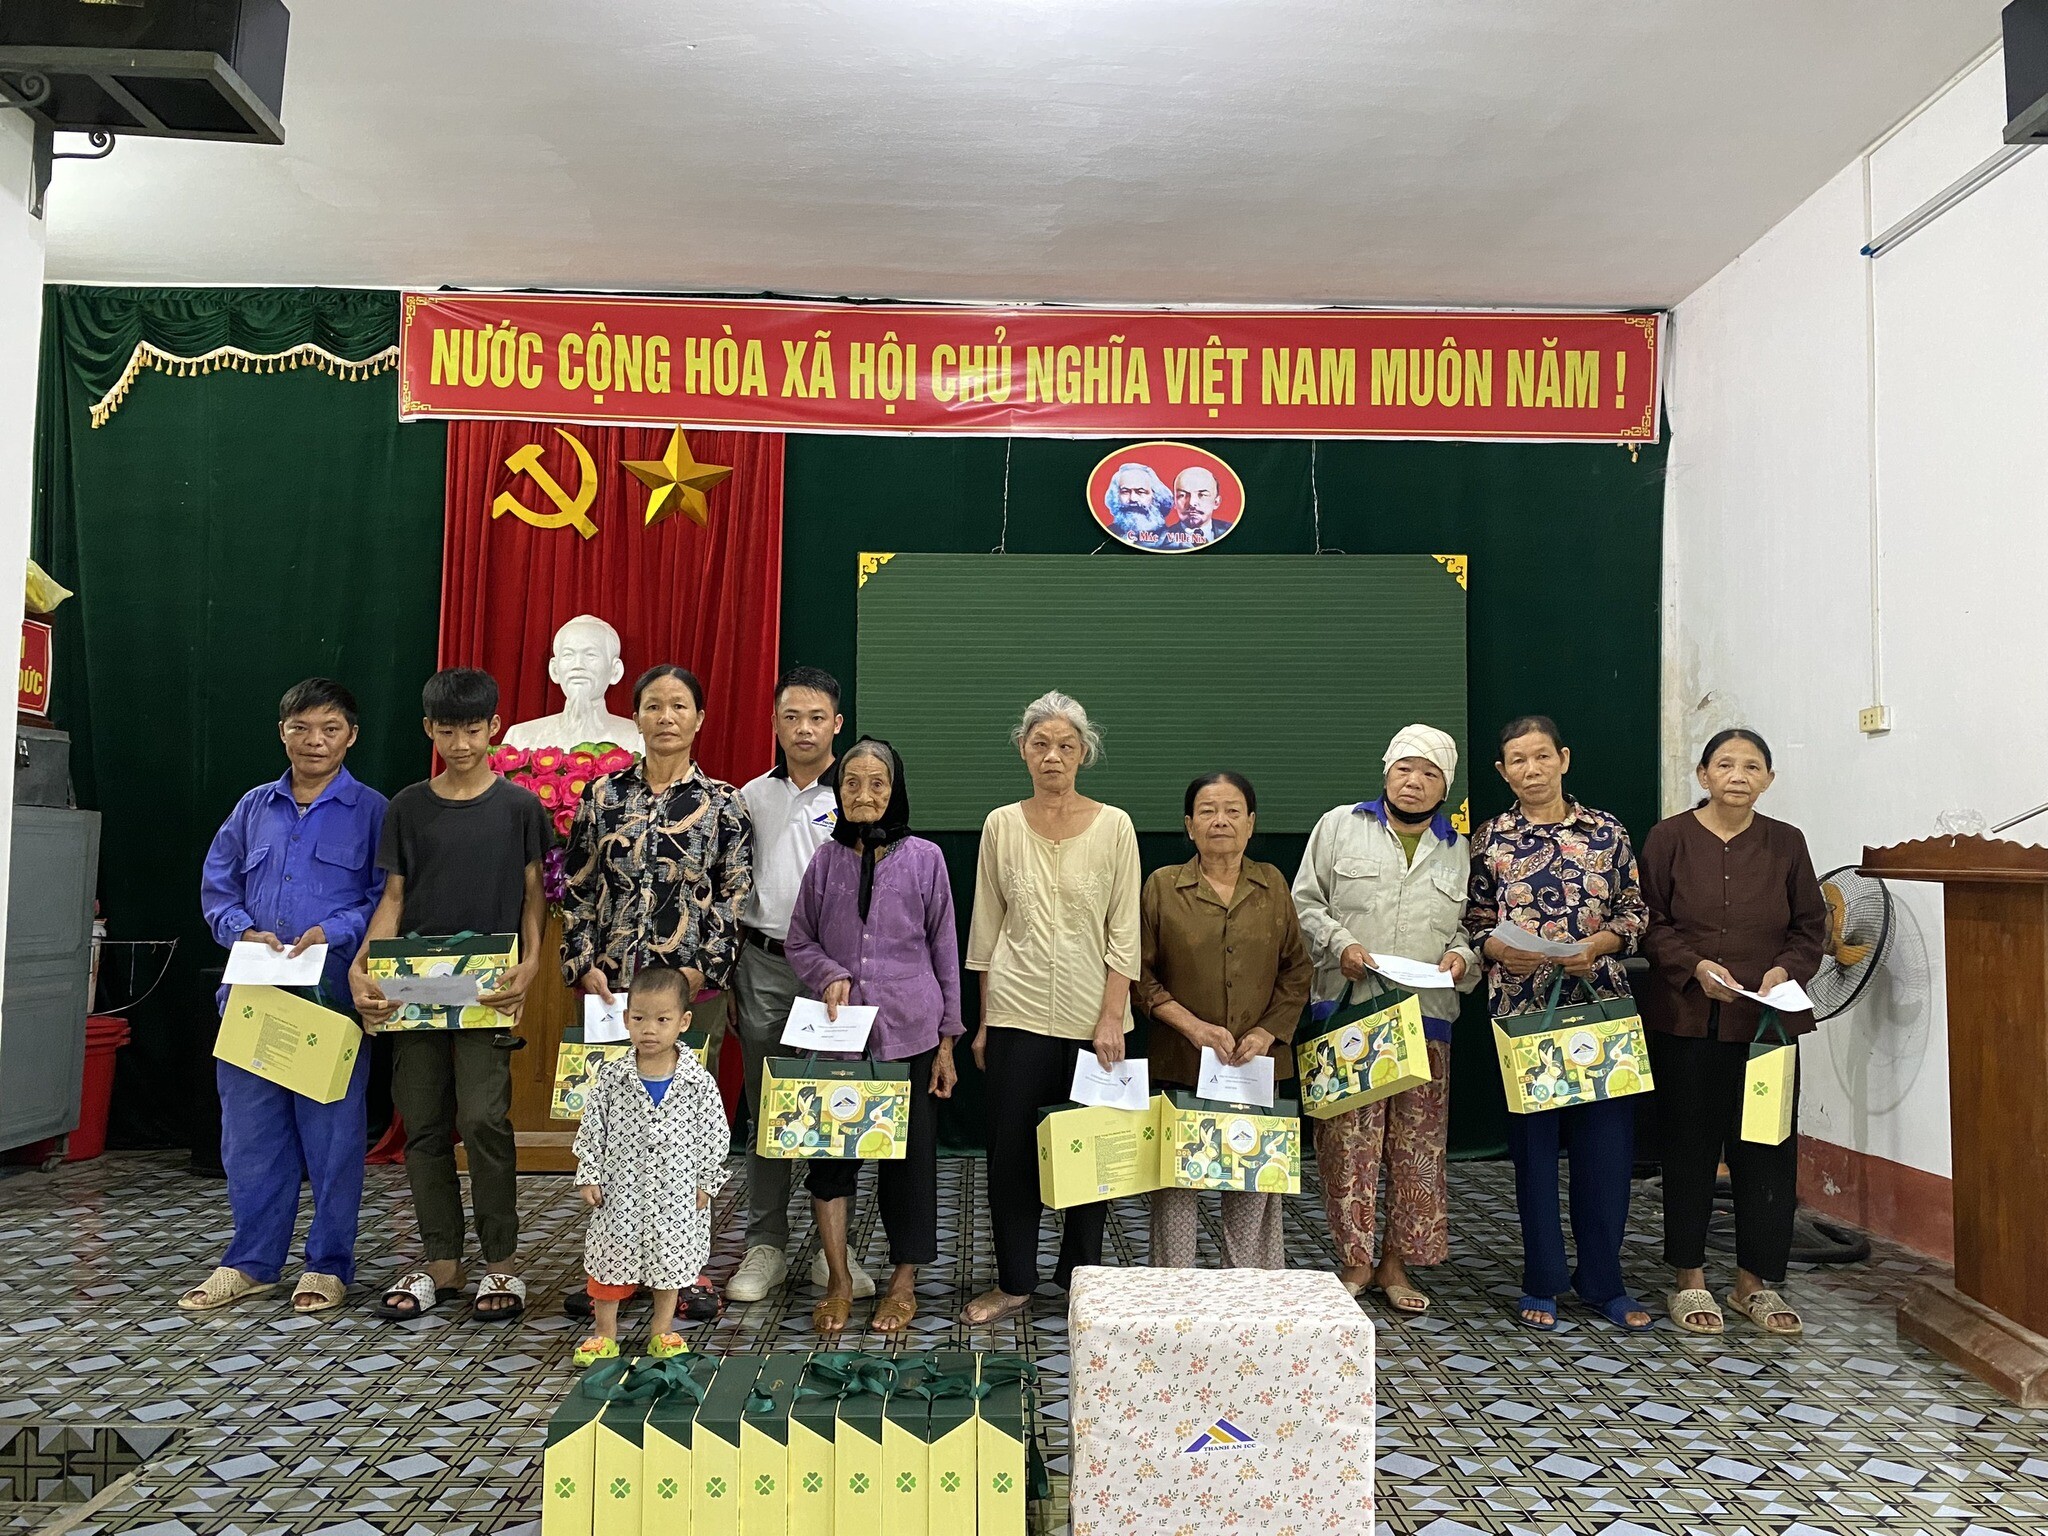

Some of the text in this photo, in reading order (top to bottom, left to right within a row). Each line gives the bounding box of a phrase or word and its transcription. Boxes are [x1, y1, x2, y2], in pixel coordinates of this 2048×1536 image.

[430, 320, 542, 390] NƯỚC
[558, 322, 671, 404] CỘNG
[685, 325, 769, 397] HÒA
[781, 327, 838, 399] XÃ
[850, 331, 916, 414] HỘI
[932, 326, 1012, 404] CHỦ
[1026, 335, 1150, 404] NGHĨA
[1163, 335, 1249, 418] VIỆT
[1262, 348, 1355, 405] NAM
[1372, 337, 1492, 407] MUÔN
[1507, 336, 1600, 408] NĂM
